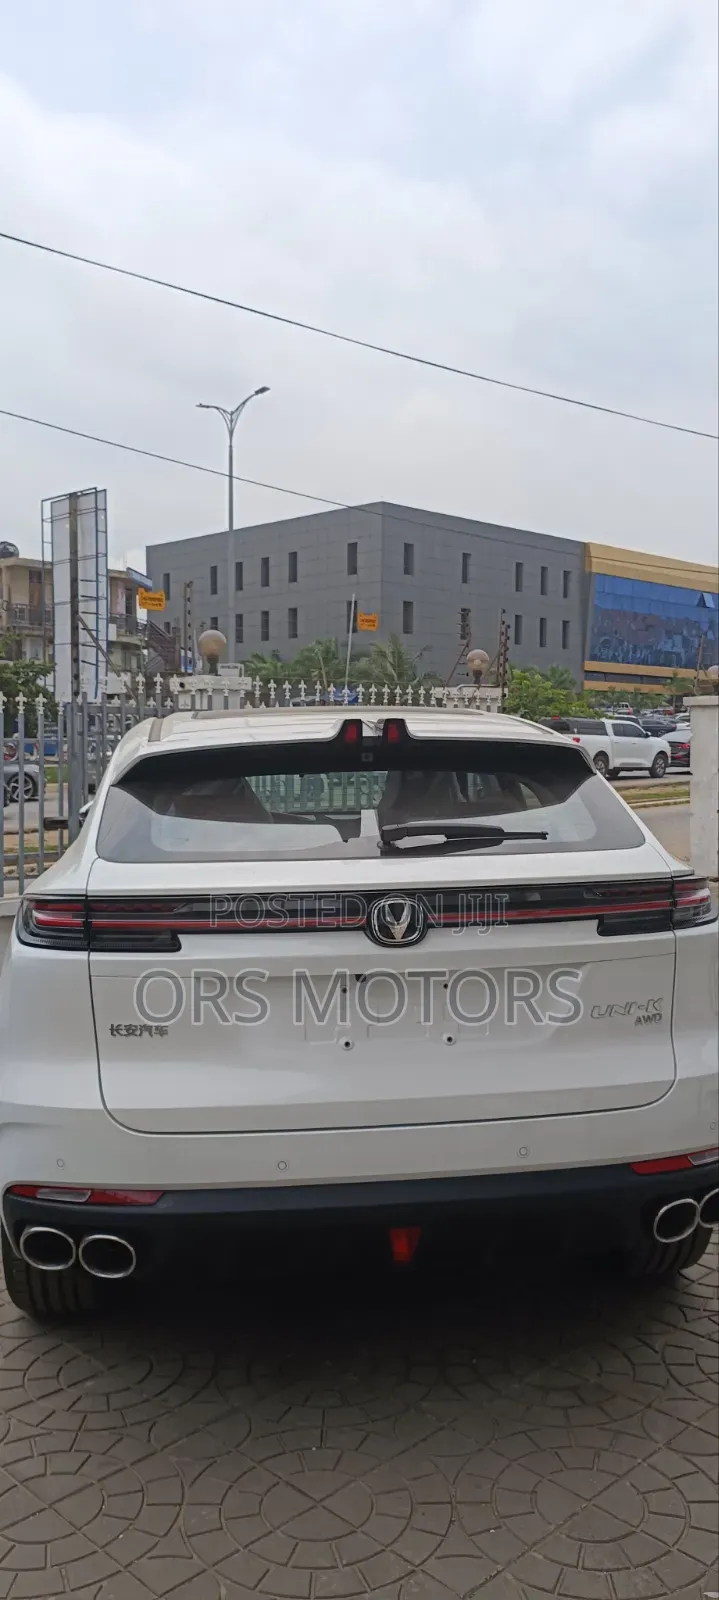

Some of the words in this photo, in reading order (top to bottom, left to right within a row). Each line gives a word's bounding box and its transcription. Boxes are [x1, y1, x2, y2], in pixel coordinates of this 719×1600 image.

[590, 997, 663, 1019] UNI-K
[634, 1013, 662, 1026] AWD
[109, 1023, 169, 1037] 长安汽车
